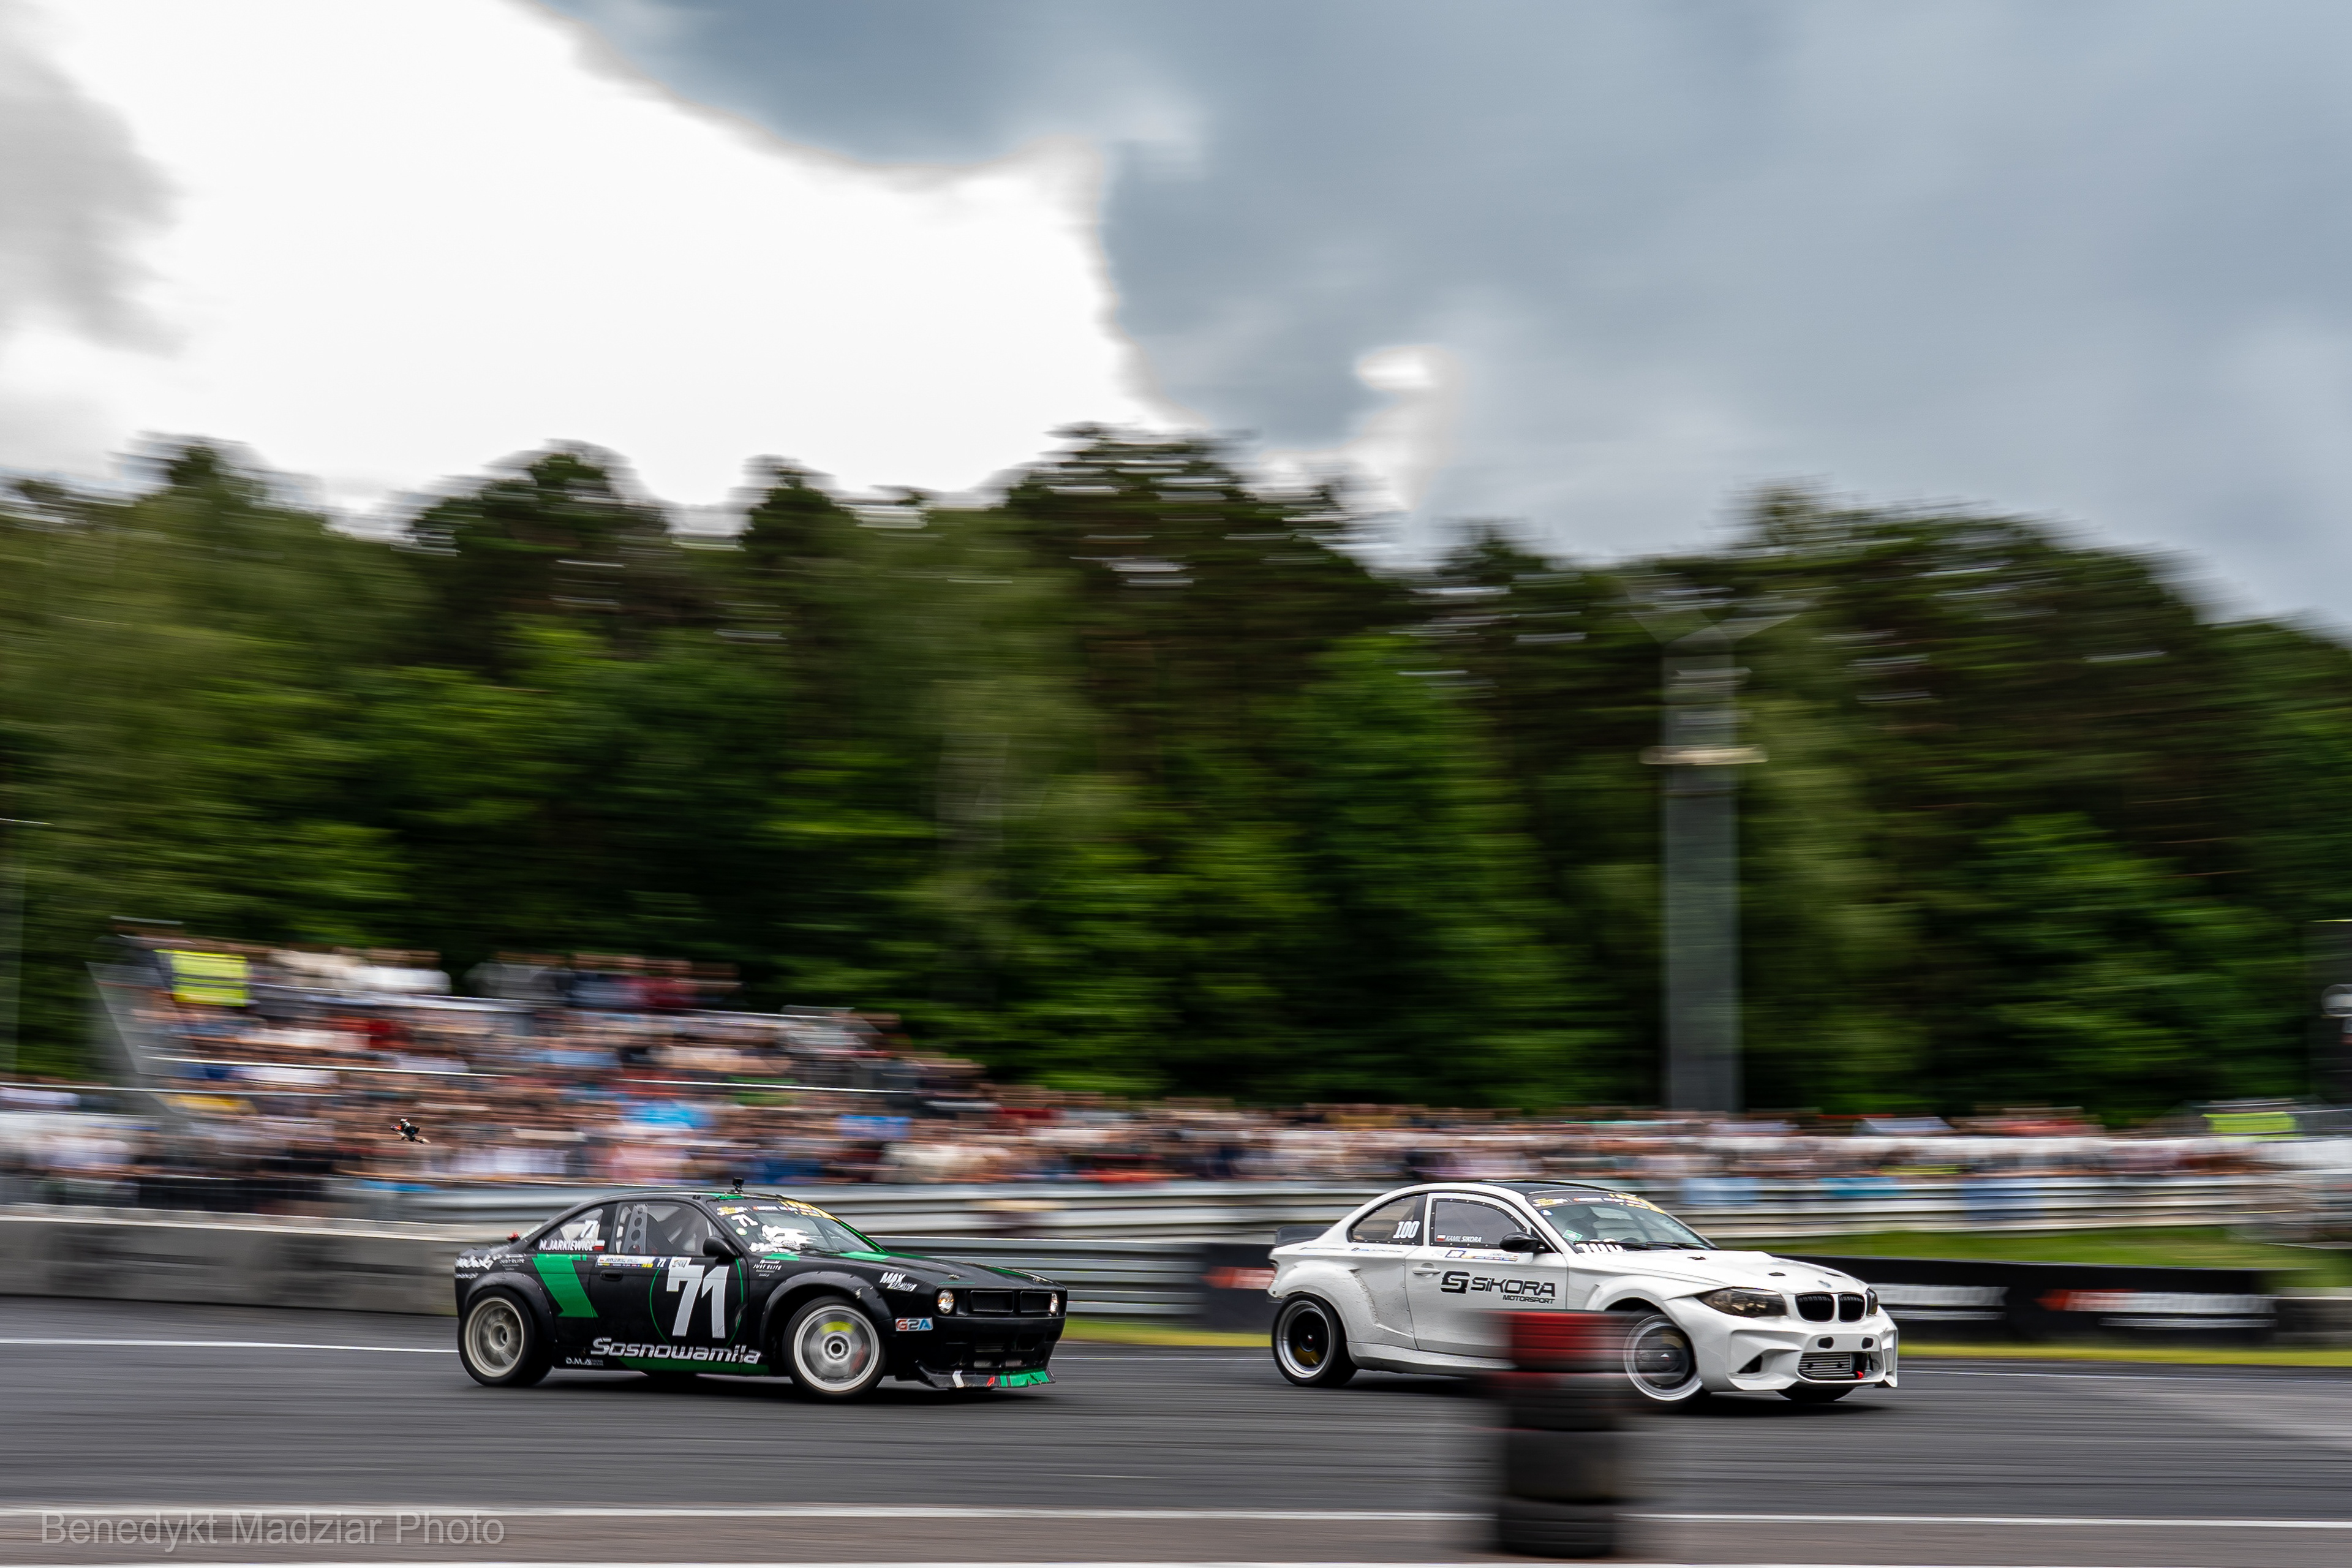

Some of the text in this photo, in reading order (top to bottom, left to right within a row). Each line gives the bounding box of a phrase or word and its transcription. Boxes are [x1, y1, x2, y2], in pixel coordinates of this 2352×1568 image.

[1392, 1221, 1420, 1239] 100
[880, 1272, 907, 1284] MAX
[666, 1265, 730, 1339] 71
[1502, 1294, 1556, 1305] MOTORSPORT
[896, 1318, 932, 1331] G2A
